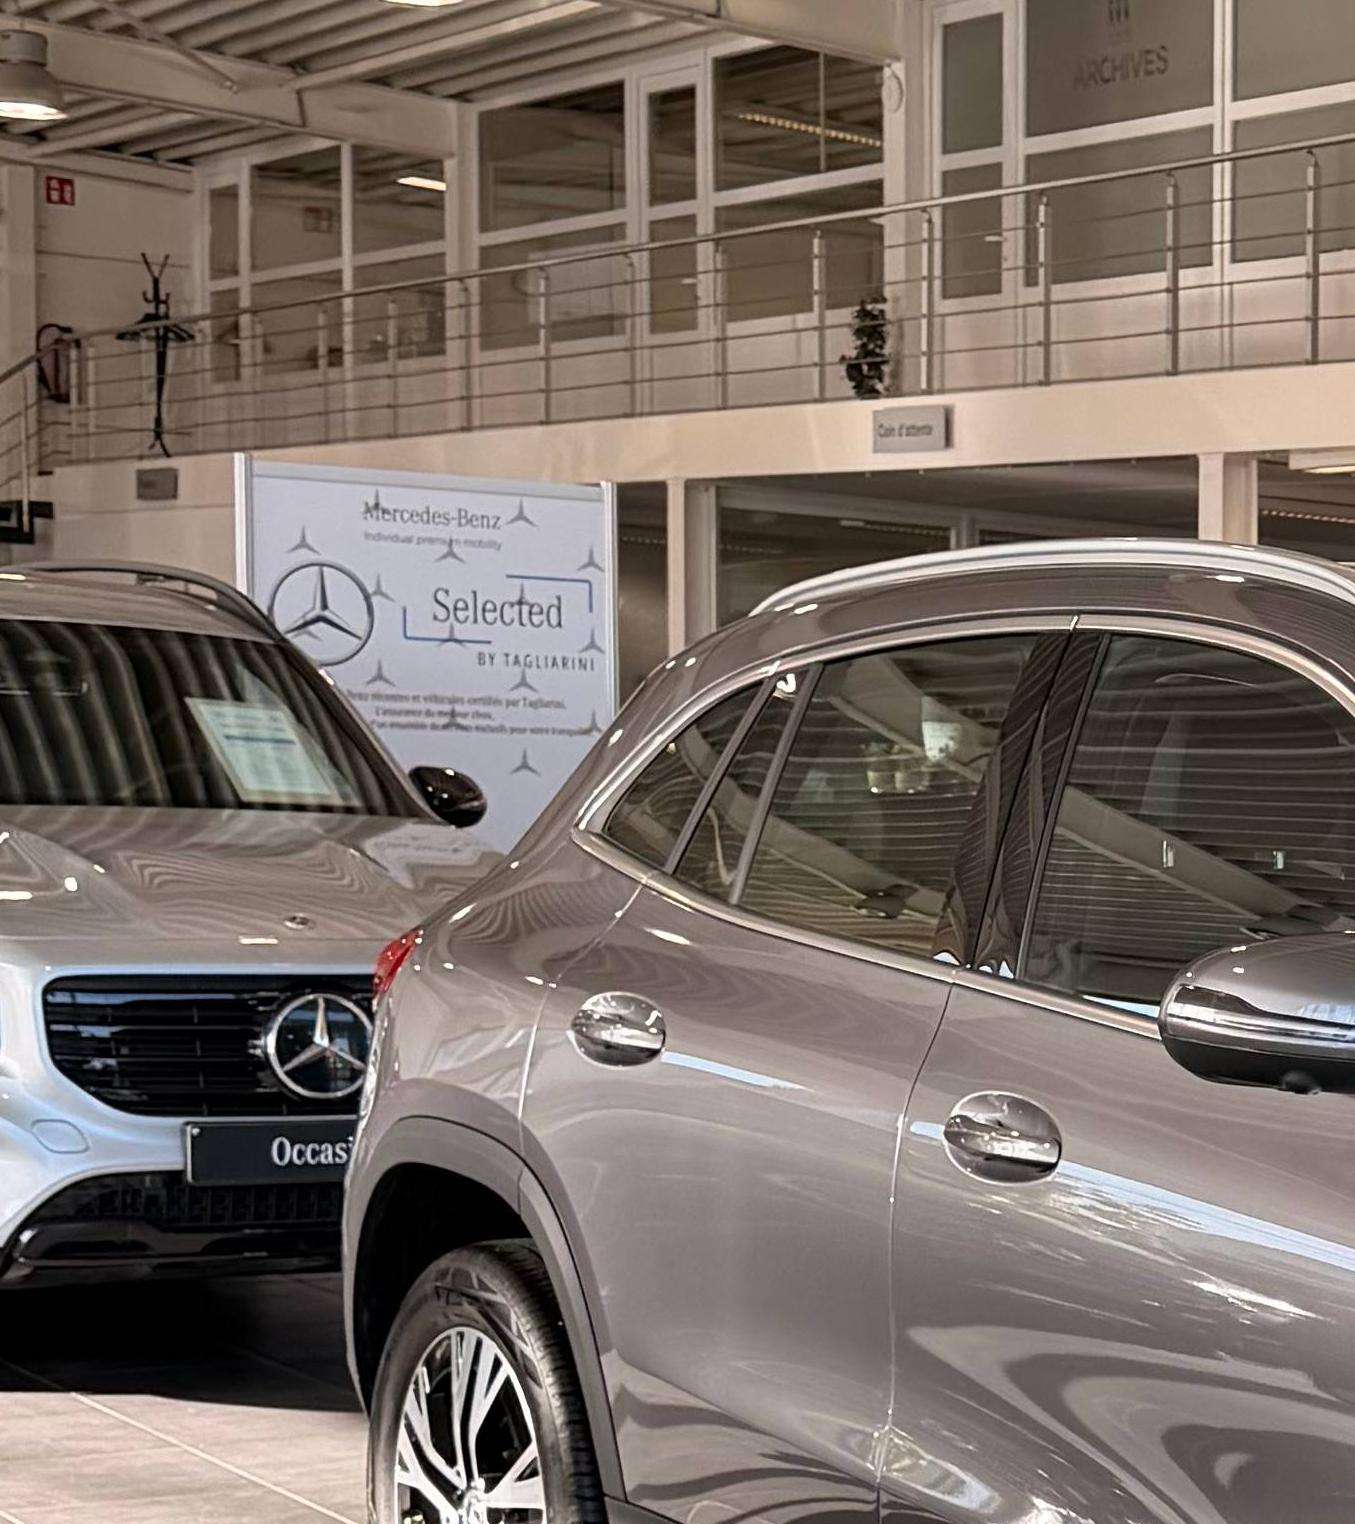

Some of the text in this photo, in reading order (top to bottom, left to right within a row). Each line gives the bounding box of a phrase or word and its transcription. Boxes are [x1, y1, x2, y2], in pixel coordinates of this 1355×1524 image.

[1073, 45, 1169, 90] ARCHIVES
[363, 501, 501, 530] Mercedes-Benz
[364, 531, 412, 547] Individual
[432, 587, 563, 629] Selected
[478, 652, 596, 671] BY TAGLIARINI
